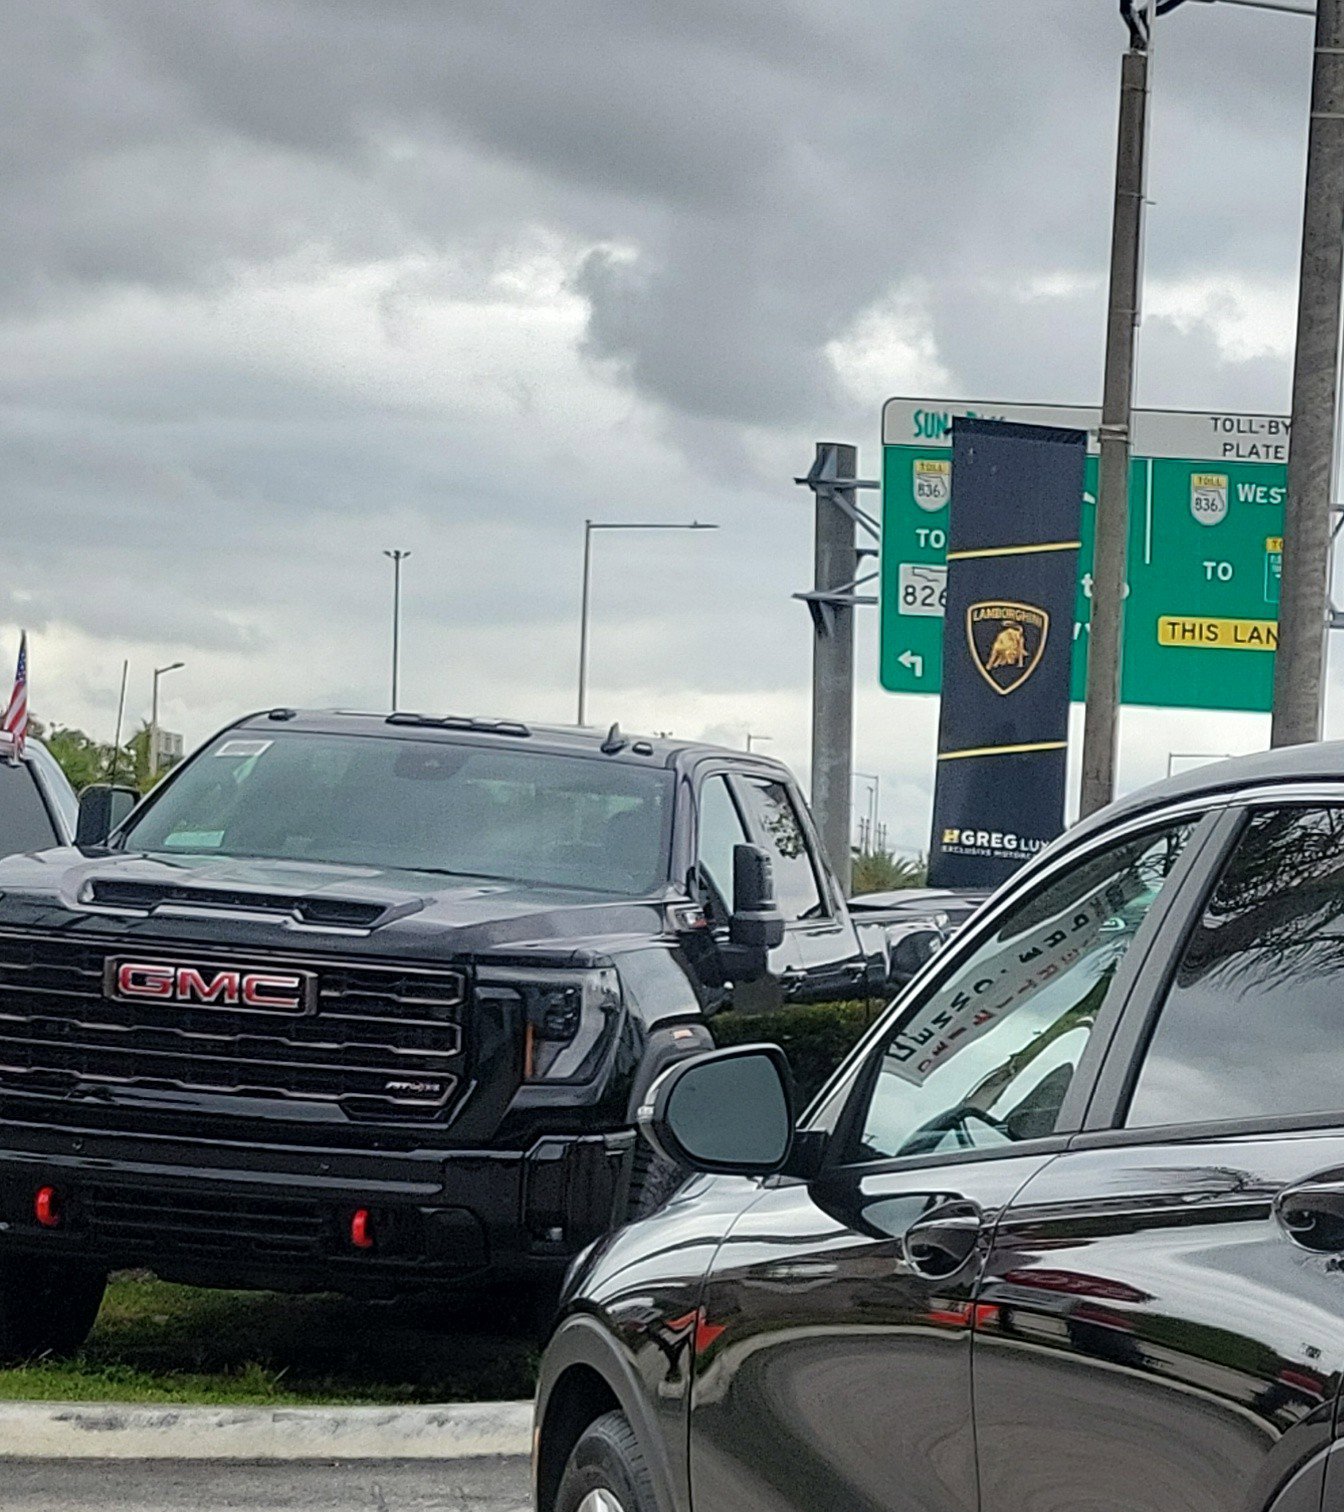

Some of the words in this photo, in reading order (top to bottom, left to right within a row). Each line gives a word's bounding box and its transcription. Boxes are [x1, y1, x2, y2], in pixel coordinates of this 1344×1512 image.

[1222, 442, 1285, 460] PLATE
[917, 483, 941, 498] 836
[1197, 475, 1223, 487] TOLL
[1194, 496, 1219, 512] 836
[915, 529, 946, 548] TO
[1202, 560, 1233, 581] TO
[903, 584, 947, 607] 826
[1166, 621, 1219, 642] THIS
[1233, 625, 1280, 646] LAN
[118, 963, 301, 1009] GMC
